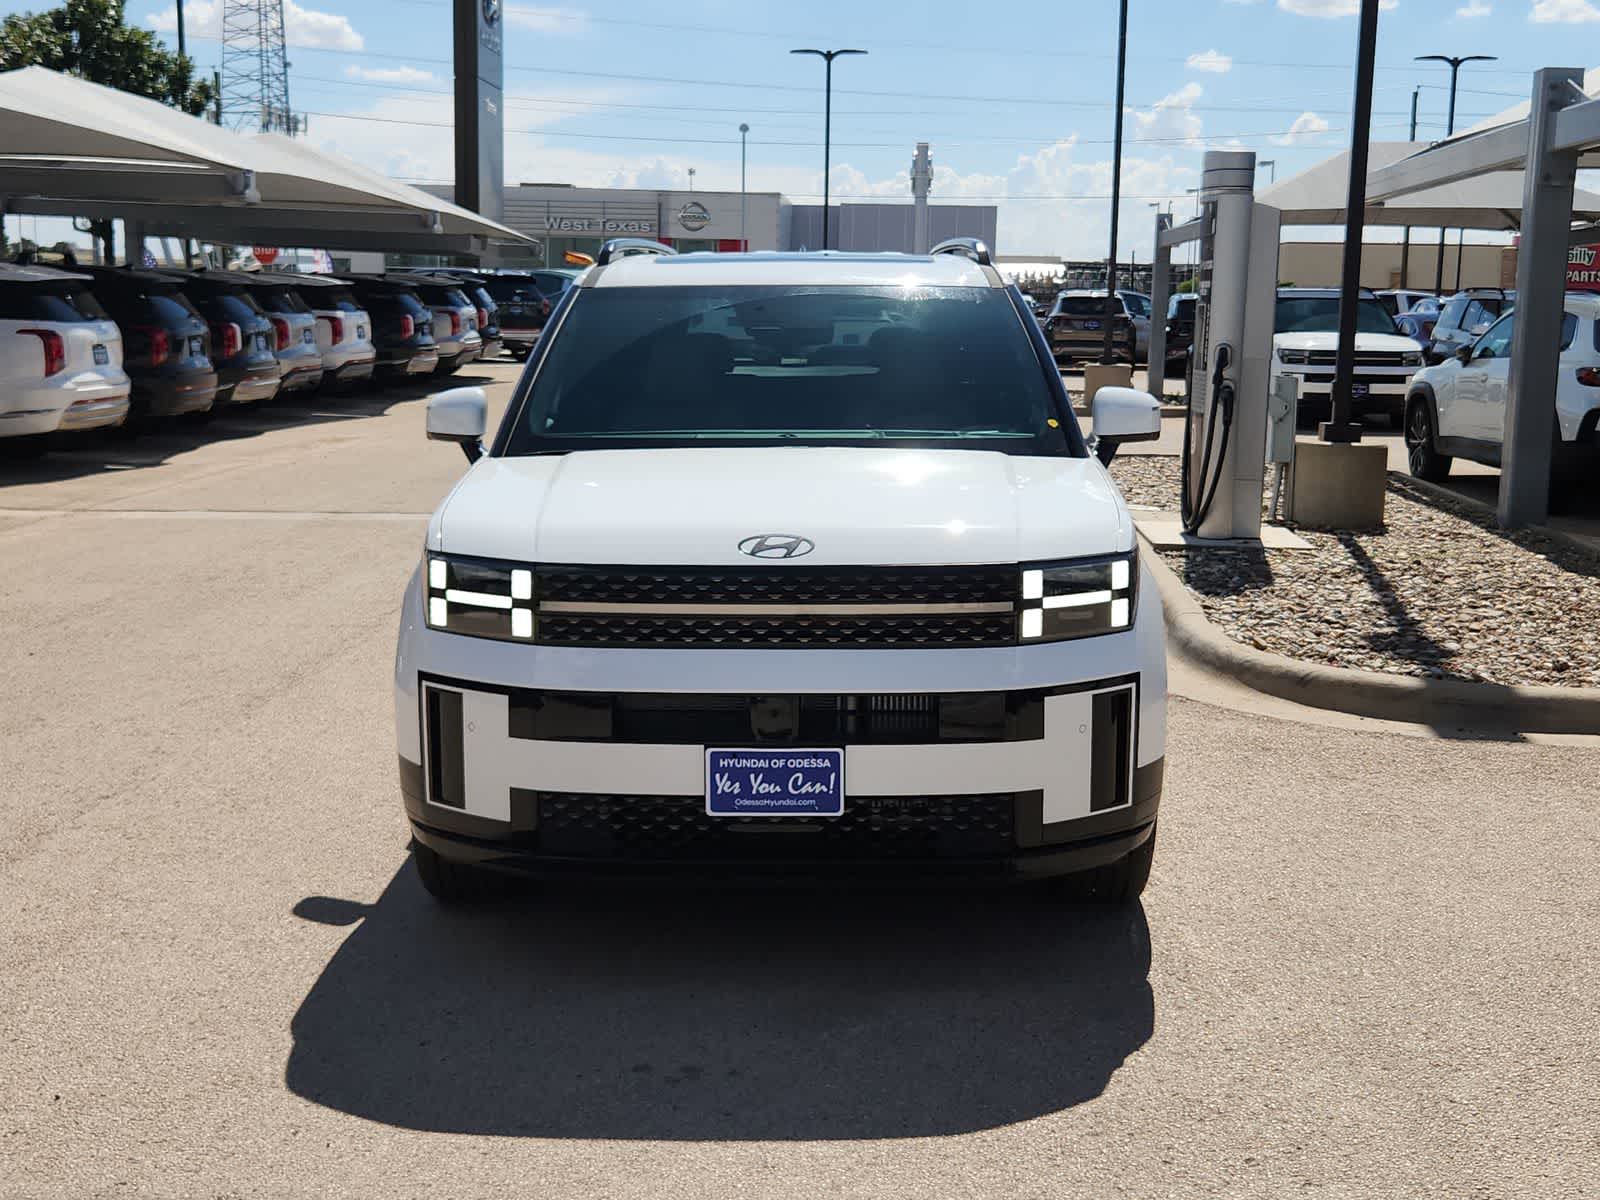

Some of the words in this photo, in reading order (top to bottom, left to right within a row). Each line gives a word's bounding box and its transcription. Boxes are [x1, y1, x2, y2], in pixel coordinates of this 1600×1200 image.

[543, 216, 591, 231] West
[598, 218, 650, 232] Texas
[719, 758, 769, 768] HYUNDAI
[770, 758, 786, 768] OF
[787, 758, 831, 768] ODESSA
[715, 772, 742, 795] Yes
[750, 772, 782, 794] You
[788, 772, 836, 794] Can!
[734, 798, 816, 807] OdessaHyundai.com
